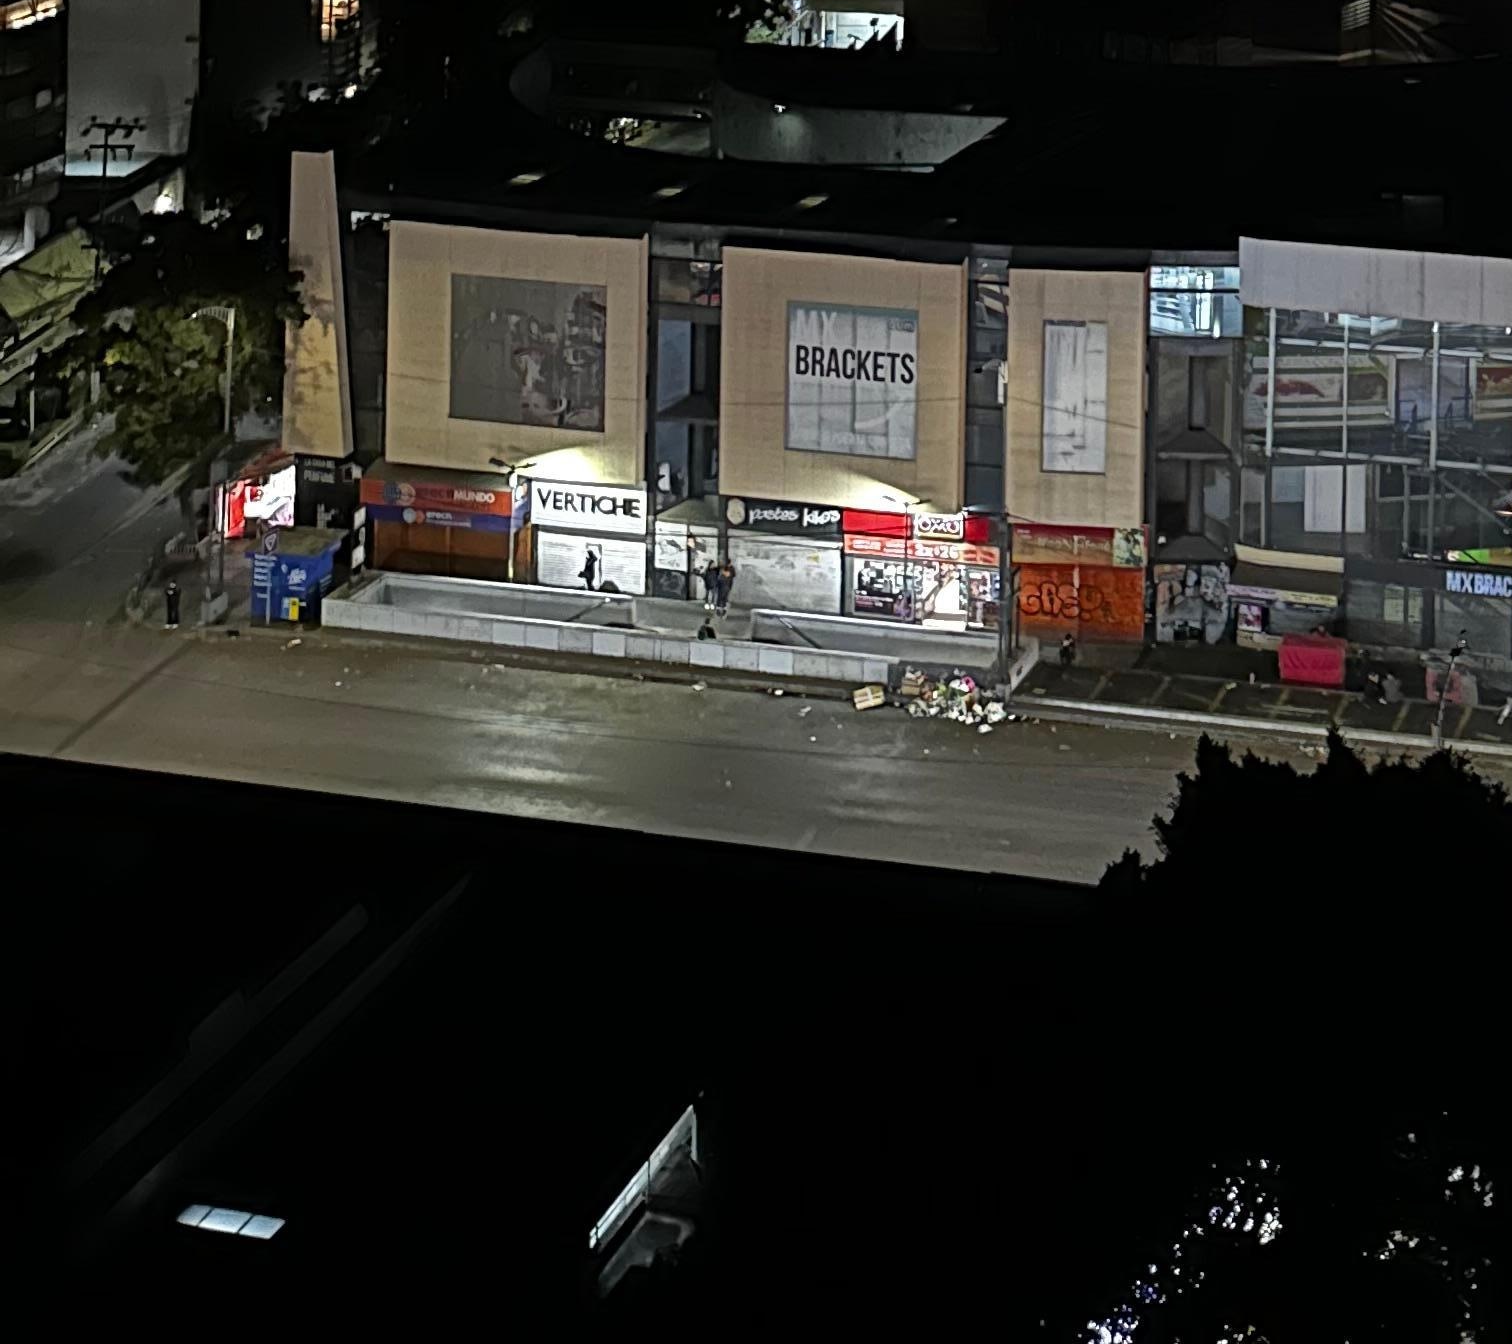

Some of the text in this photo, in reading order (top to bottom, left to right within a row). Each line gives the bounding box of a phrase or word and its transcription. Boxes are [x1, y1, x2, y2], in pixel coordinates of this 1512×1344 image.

[795, 344, 915, 385] BRACKETS
[453, 489, 496, 504] MUNDO
[537, 487, 641, 518] VERTICHE
